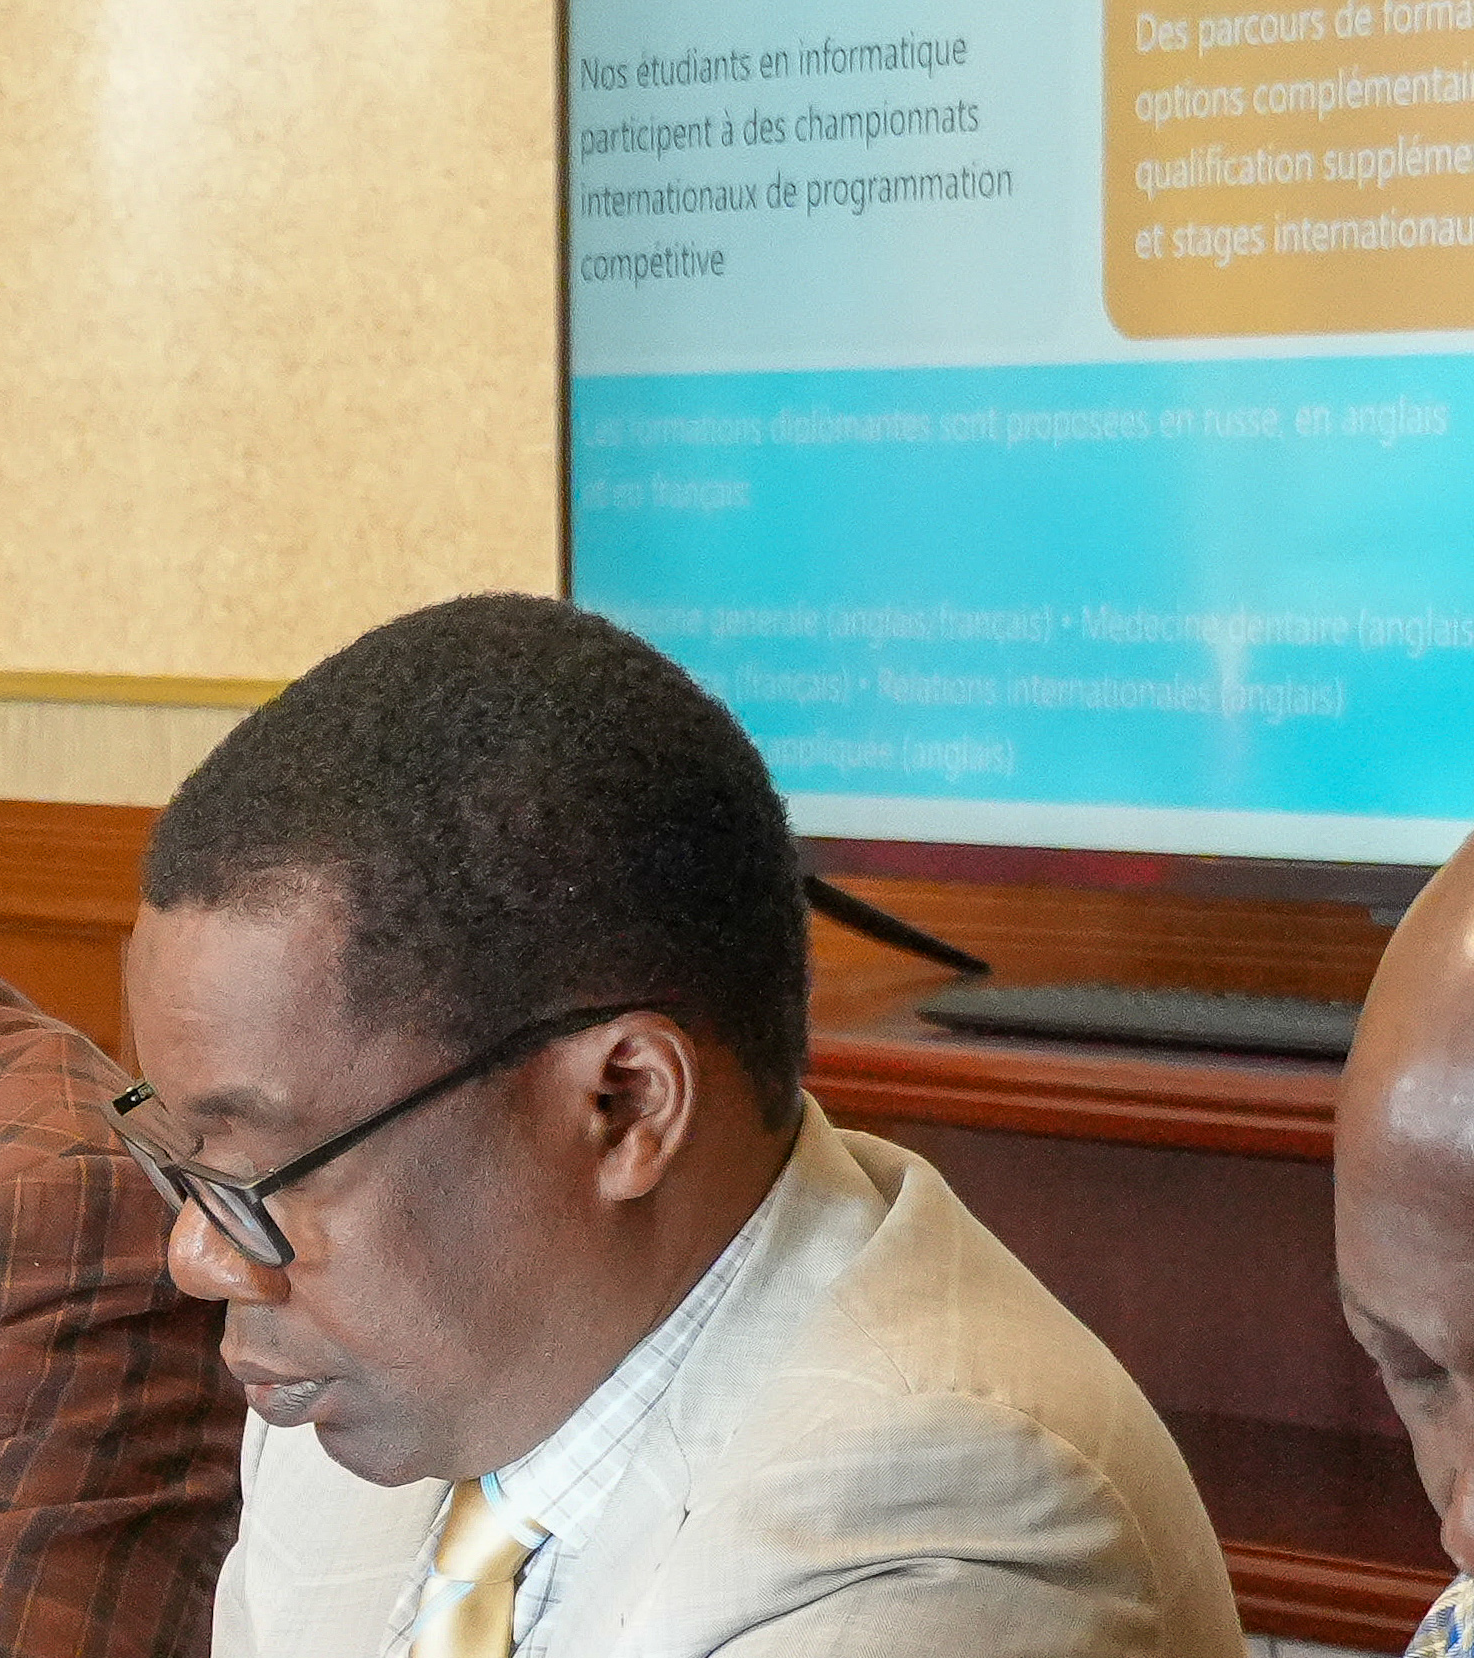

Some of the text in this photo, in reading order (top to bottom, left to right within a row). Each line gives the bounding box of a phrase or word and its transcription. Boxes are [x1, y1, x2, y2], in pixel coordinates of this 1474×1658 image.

[1135, 12, 1189, 54] Des
[1198, 8, 1325, 57] parcours
[1335, 1, 1373, 39] de
[580, 34, 969, 90] Nos étudiants en informatique
[580, 98, 980, 163] participent à des championnats
[1135, 82, 1244, 130] options
[580, 163, 1014, 219] internationaux de programmation
[1135, 143, 1313, 200] qualification
[580, 243, 725, 287] compétitive
[1135, 225, 1164, 260] et
[1172, 215, 1266, 268] stages
[1159, 407, 1196, 437] en
[1295, 404, 1332, 436] en
[1341, 395, 1450, 448] anglais
